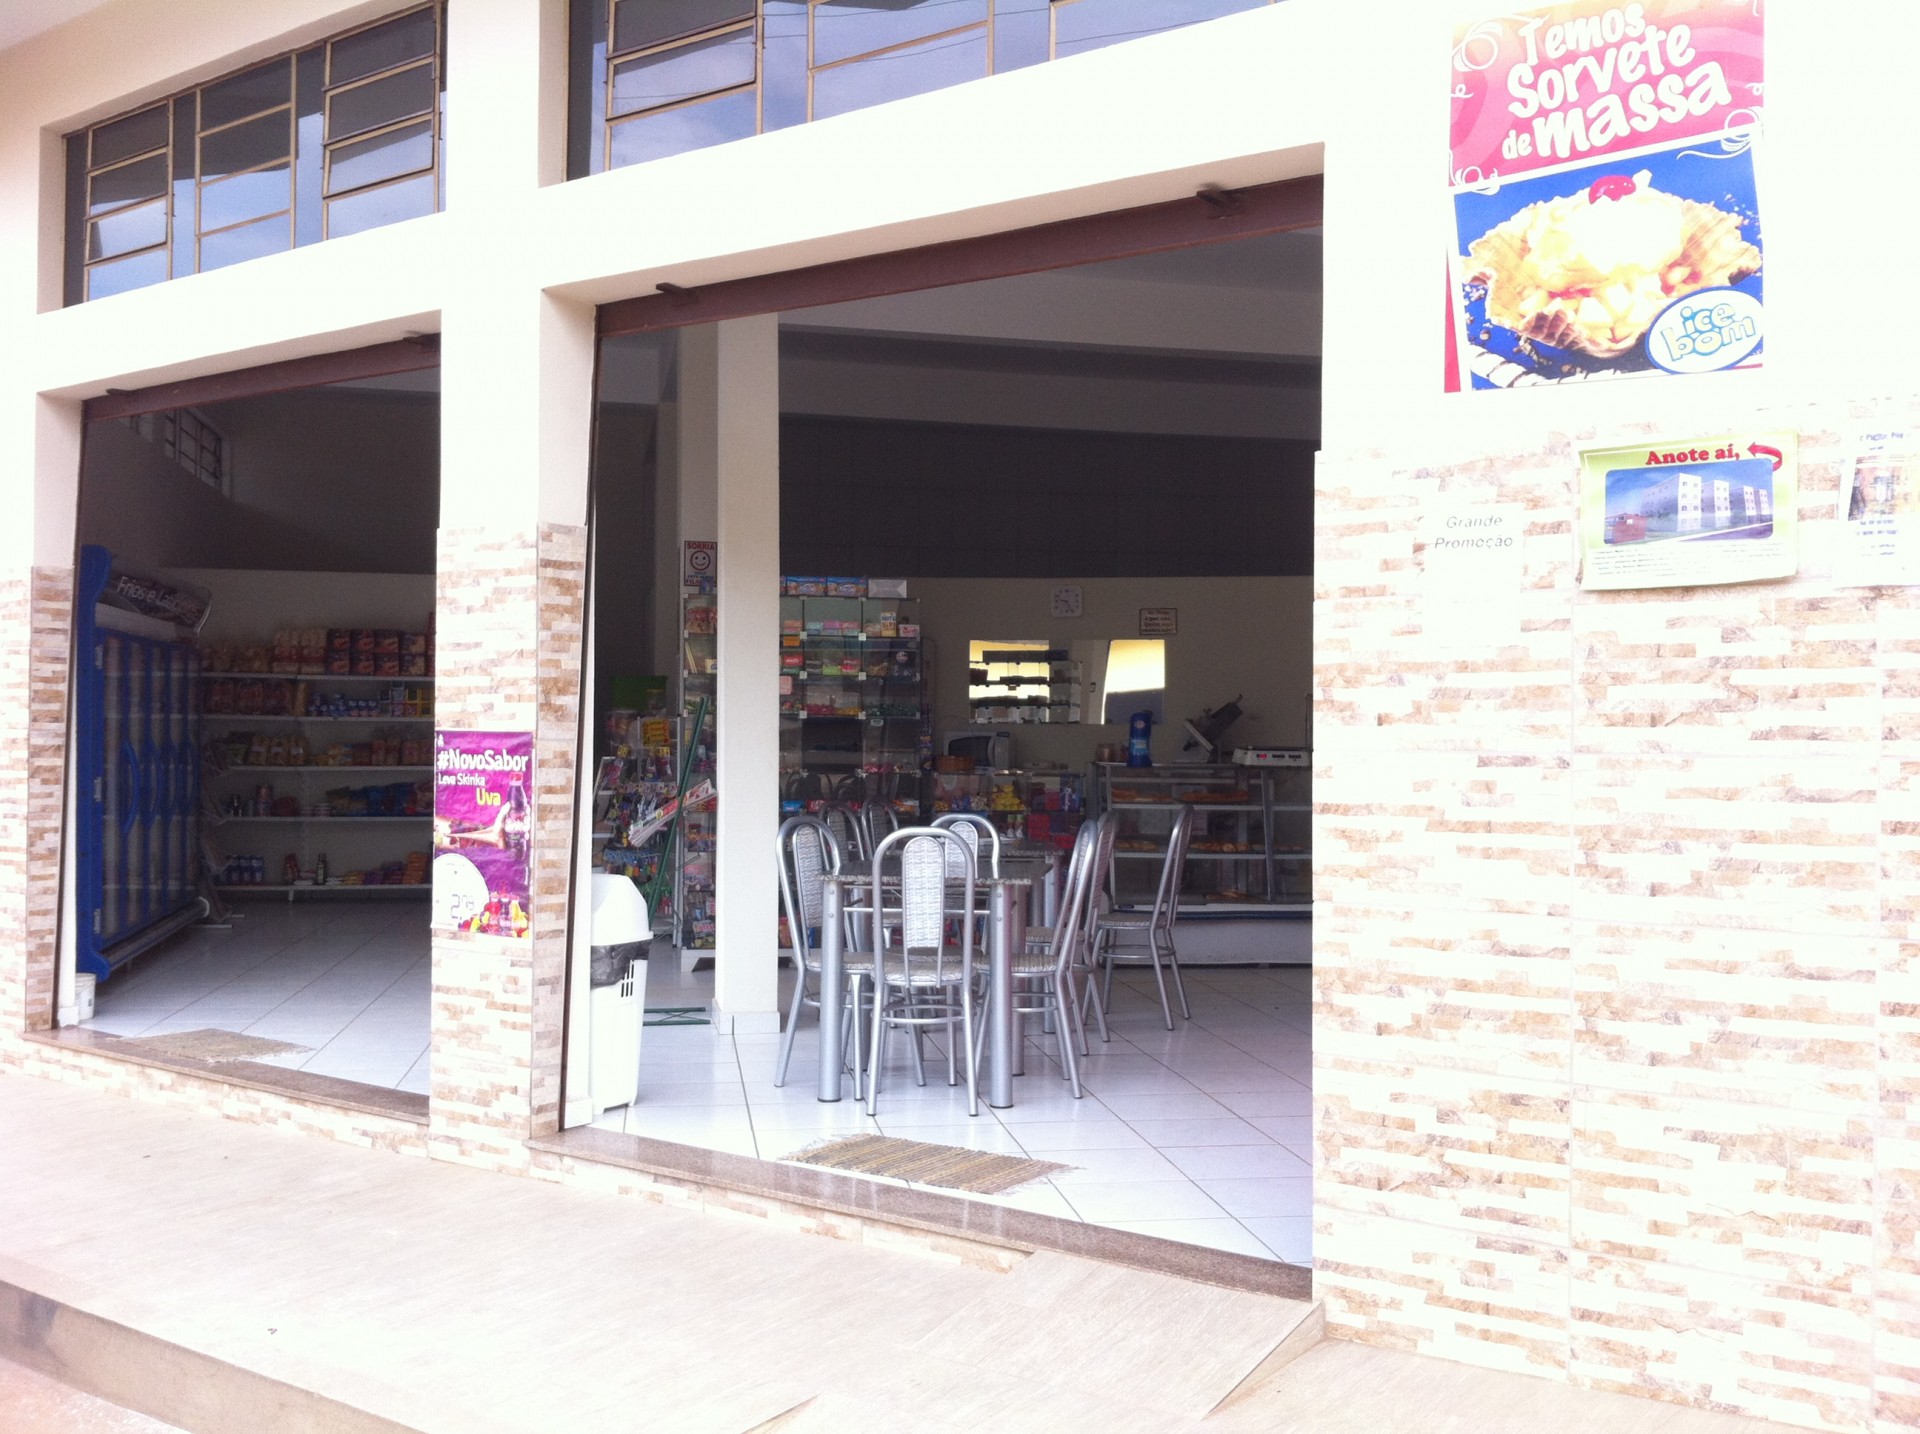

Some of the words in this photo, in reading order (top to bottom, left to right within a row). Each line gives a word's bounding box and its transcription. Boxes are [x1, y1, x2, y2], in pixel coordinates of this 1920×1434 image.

[1517, 3, 1646, 66] Temos
[1506, 23, 1696, 119] Sorvete
[1501, 129, 1533, 160] de
[1679, 302, 1736, 337] ice
[1659, 315, 1757, 362] bom
[1645, 448, 1710, 466] Anote
[1714, 443, 1741, 461] aí,
[1446, 514, 1504, 529] Grande
[687, 542, 715, 550] SORRIA
[1434, 535, 1514, 550] Promoção
[116, 576, 145, 600] Frios
[437, 748, 529, 772] #NovoSabor
[457, 773, 486, 786] Skinka
[476, 787, 501, 806] Uva
